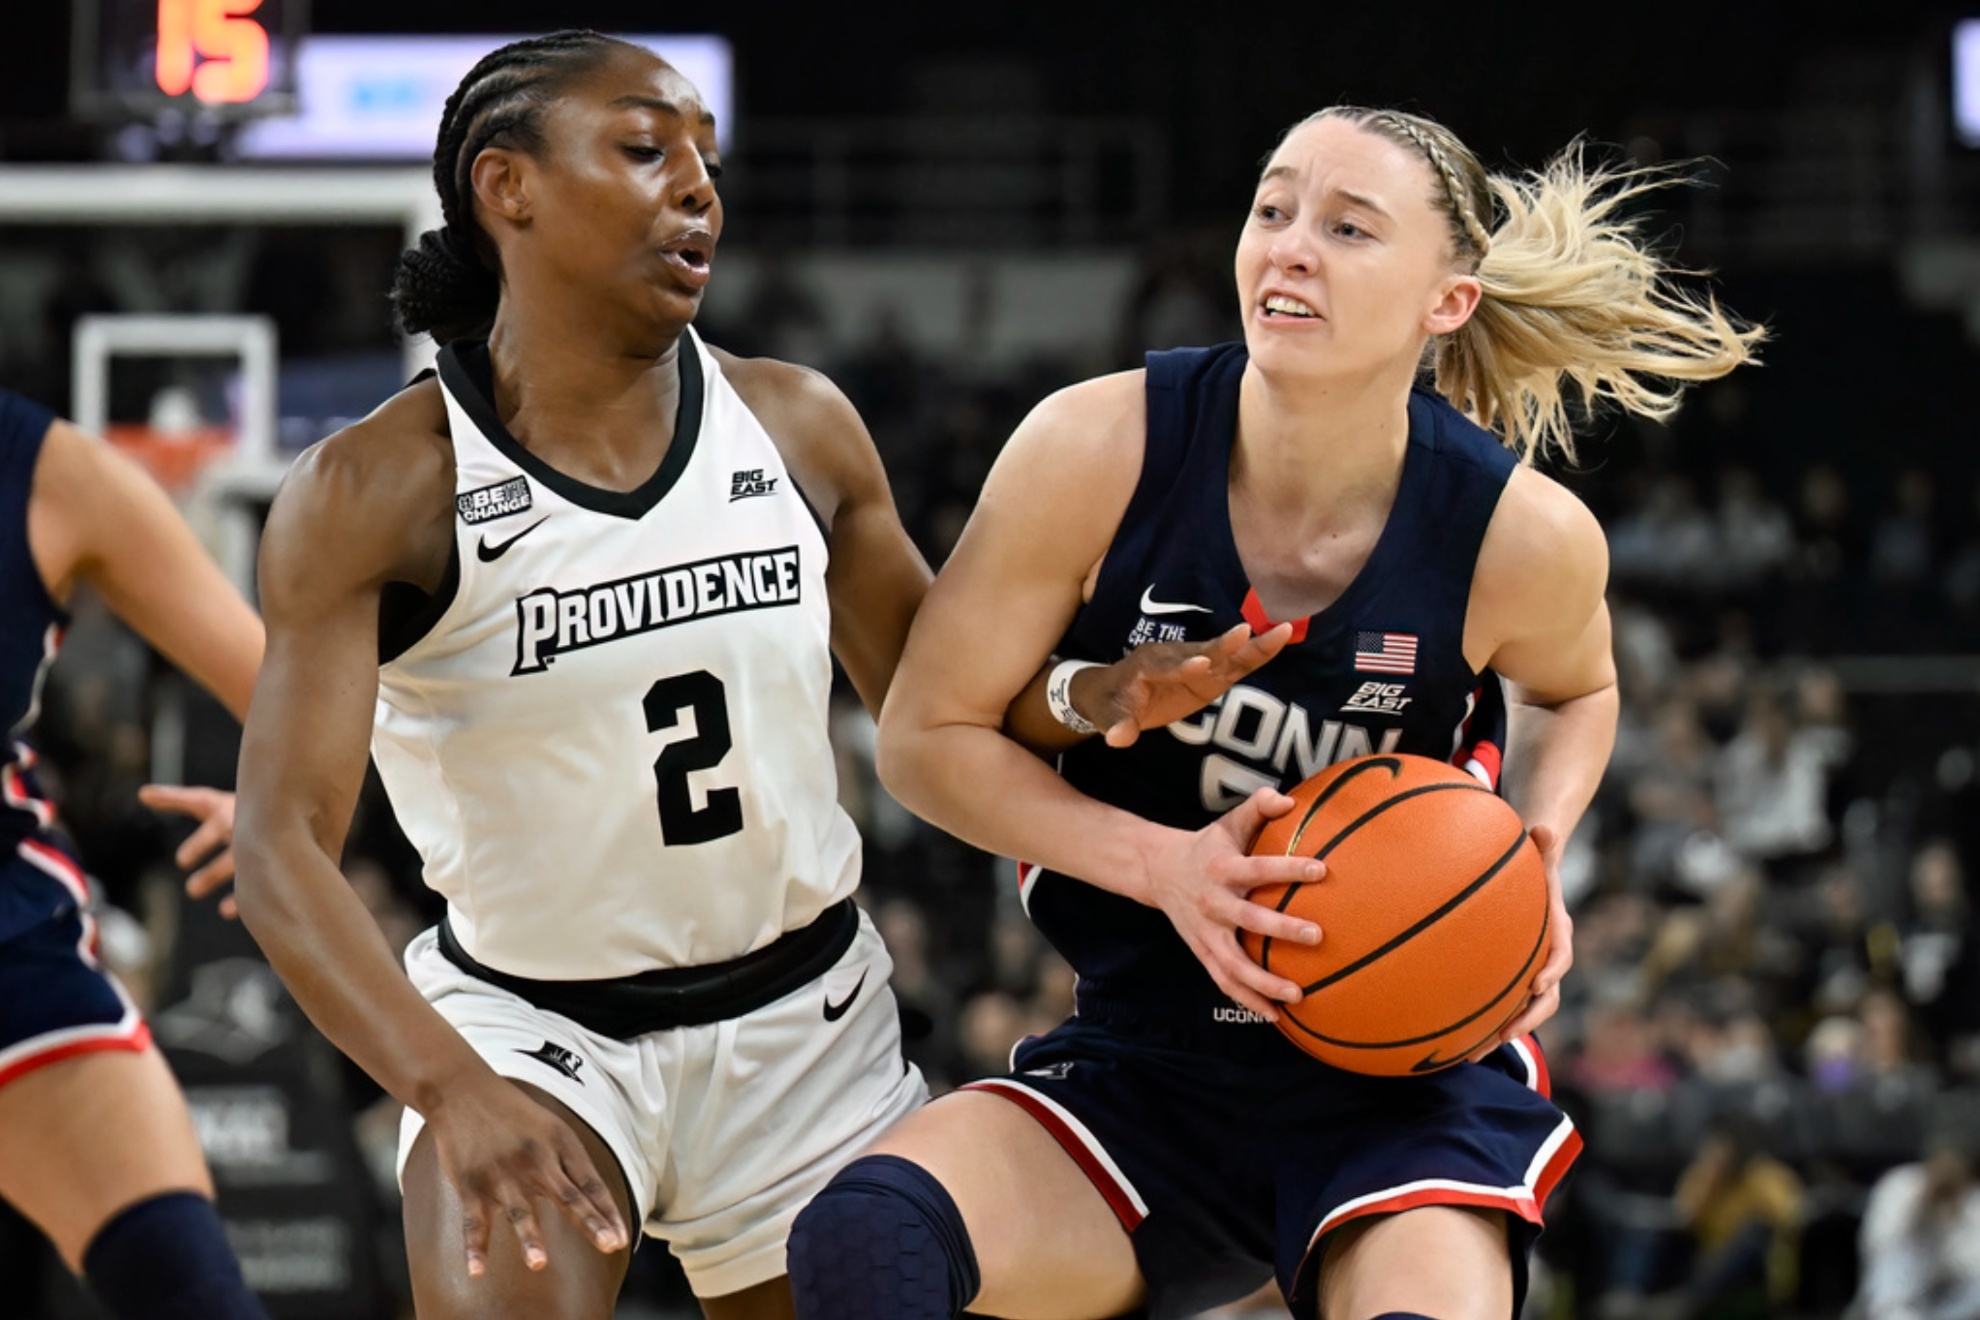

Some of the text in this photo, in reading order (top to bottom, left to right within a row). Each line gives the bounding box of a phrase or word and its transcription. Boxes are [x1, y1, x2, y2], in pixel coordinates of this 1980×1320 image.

[155, 0, 270, 104] 15
[731, 478, 778, 495] EAST
[732, 468, 764, 484] BIG
[463, 493, 530, 521] CHANGE
[1136, 617, 1156, 637] BE
[1159, 623, 1187, 642] THE
[1357, 681, 1406, 697] BIG
[1346, 692, 1413, 711] EAST
[641, 669, 744, 847] 2
